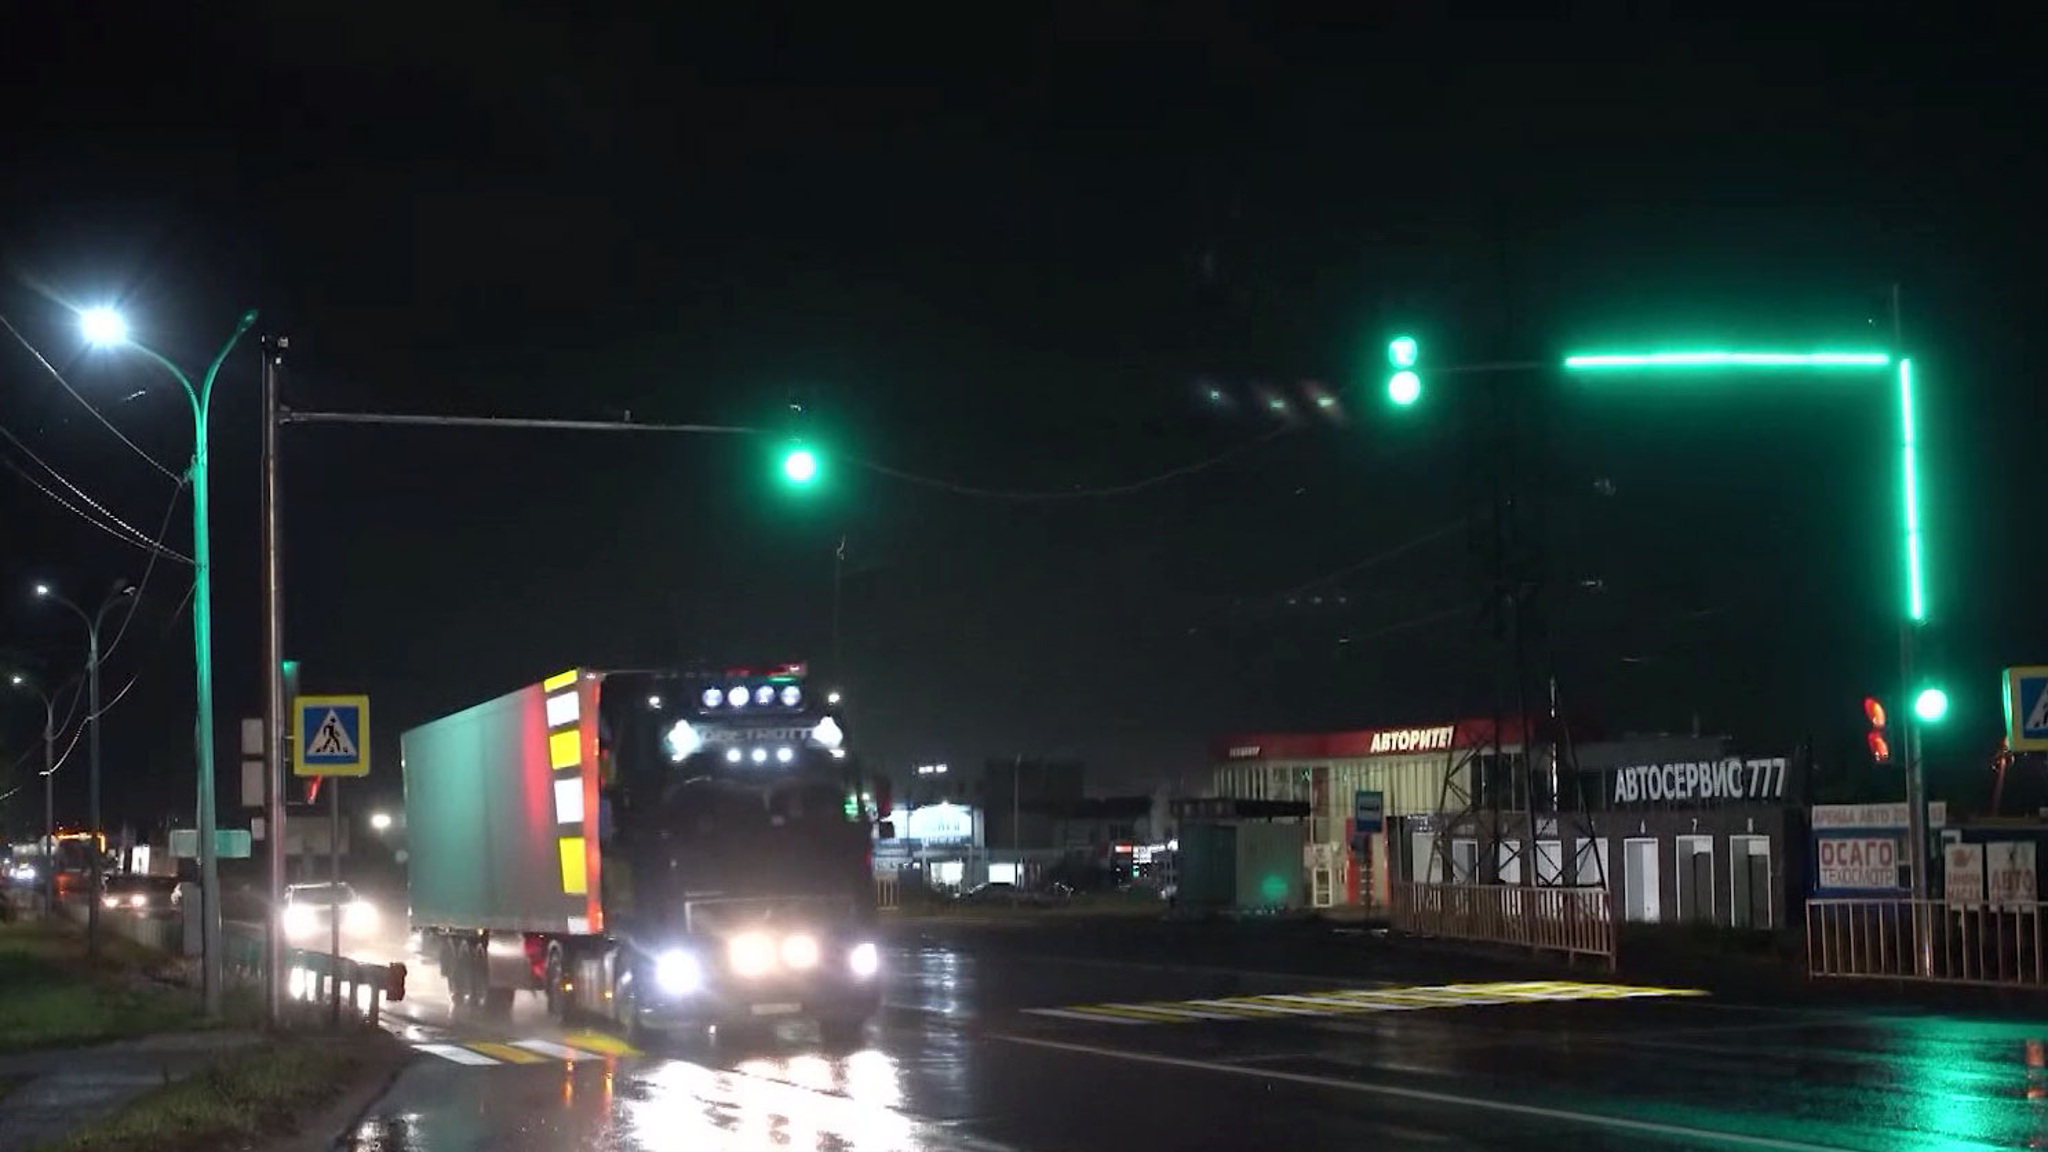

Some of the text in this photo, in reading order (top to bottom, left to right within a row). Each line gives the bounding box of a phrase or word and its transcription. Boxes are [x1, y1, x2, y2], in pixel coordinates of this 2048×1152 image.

[1614, 758, 1786, 802] АВТОСЕРВИС 777
[1821, 841, 1893, 867] ОСАГО
